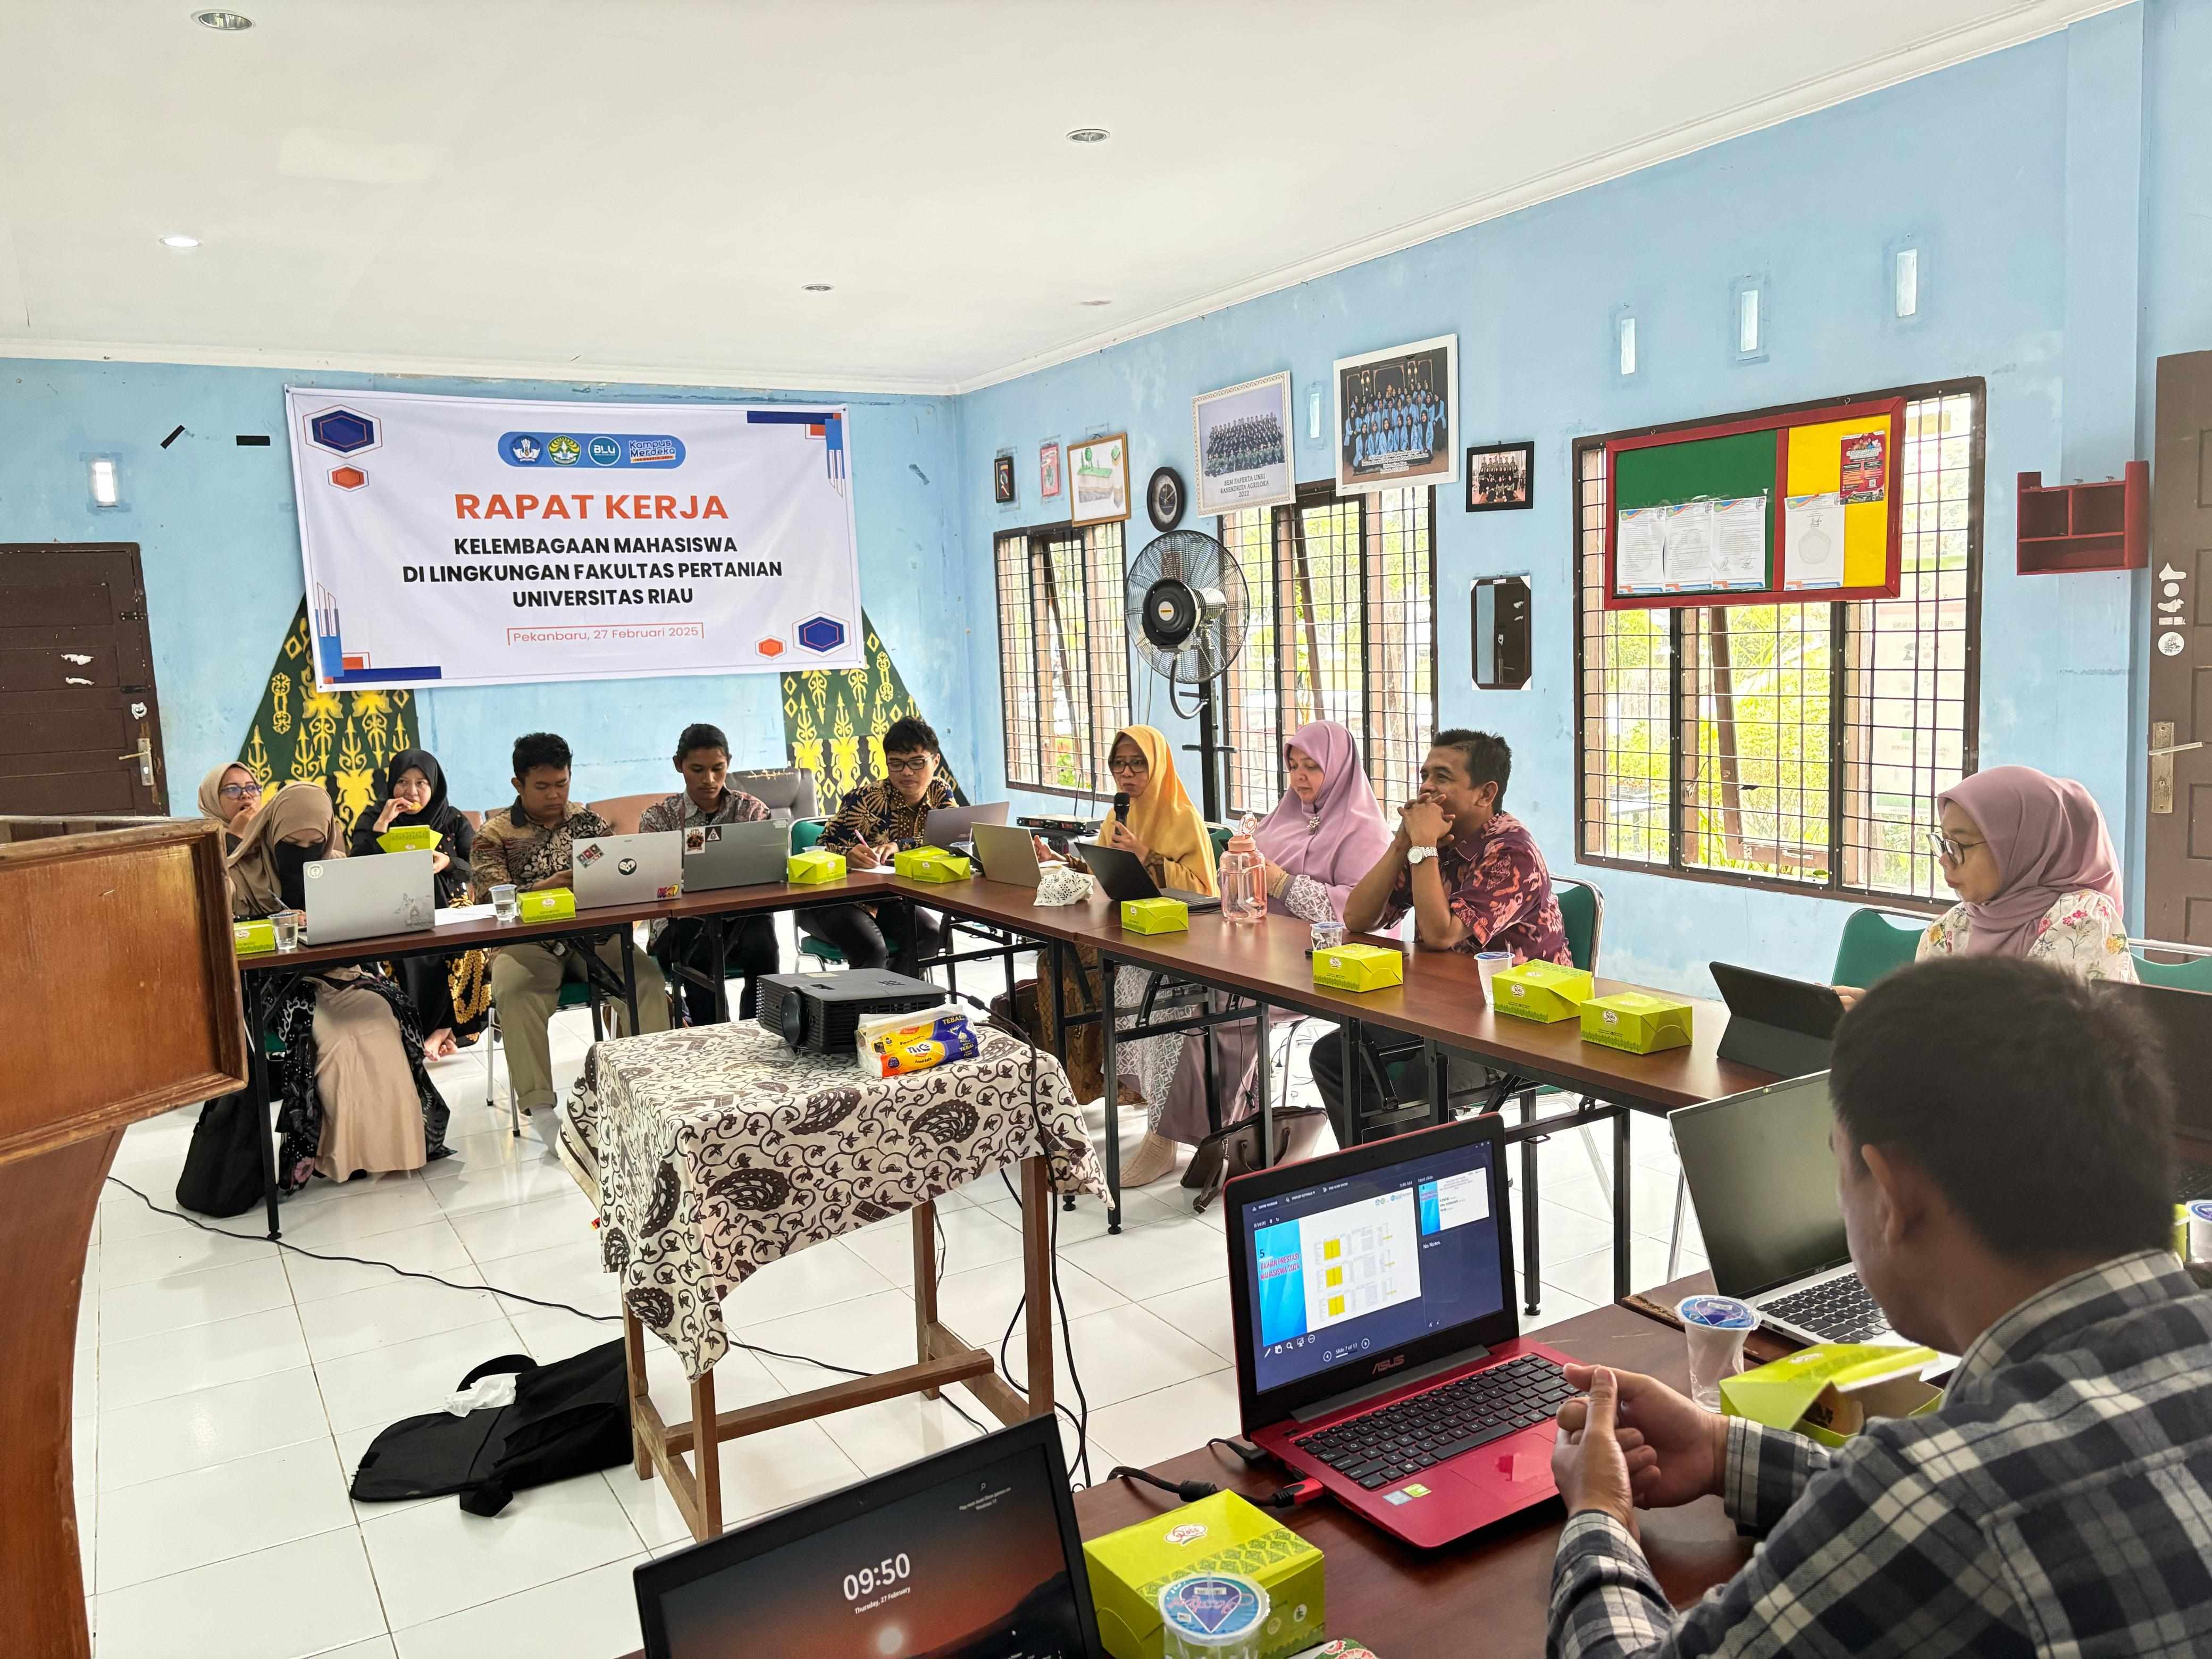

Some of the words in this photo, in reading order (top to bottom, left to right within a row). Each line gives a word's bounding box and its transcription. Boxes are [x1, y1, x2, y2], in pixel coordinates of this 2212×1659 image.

[594, 445, 615, 454] BLU
[630, 440, 672, 449] Kampus
[631, 448, 675, 457] Merdeka
[455, 494, 594, 520] RAPAT
[606, 495, 729, 520] KERJA
[455, 538, 609, 555] KELEMBAGAAN
[614, 537, 738, 553] MAHASISWA
[403, 566, 424, 583] DI
[430, 564, 569, 582] LINGKUNGAN
[574, 563, 674, 580] FAKULTAS
[678, 562, 783, 578] PERTANIAN
[513, 589, 643, 607] UNIVERSITAS
[648, 588, 693, 604] RIAU
[514, 631, 590, 642] Pekanbaru,
[593, 630, 608, 639] 27
[612, 628, 665, 639] Februari
[668, 627, 698, 637] 2025
[1260, 1249, 1264, 1258] 5
[1260, 1259, 1277, 1270] RAIHAN
[1278, 1252, 1299, 1264] PRESTASI
[1260, 1267, 1287, 1280] MAHASISWA
[1372, 1354, 1404, 1374] ASUS
[843, 1553, 910, 1601] 09:50
[855, 1600, 881, 1614] Thursday,
[887, 1587, 911, 1600] February
